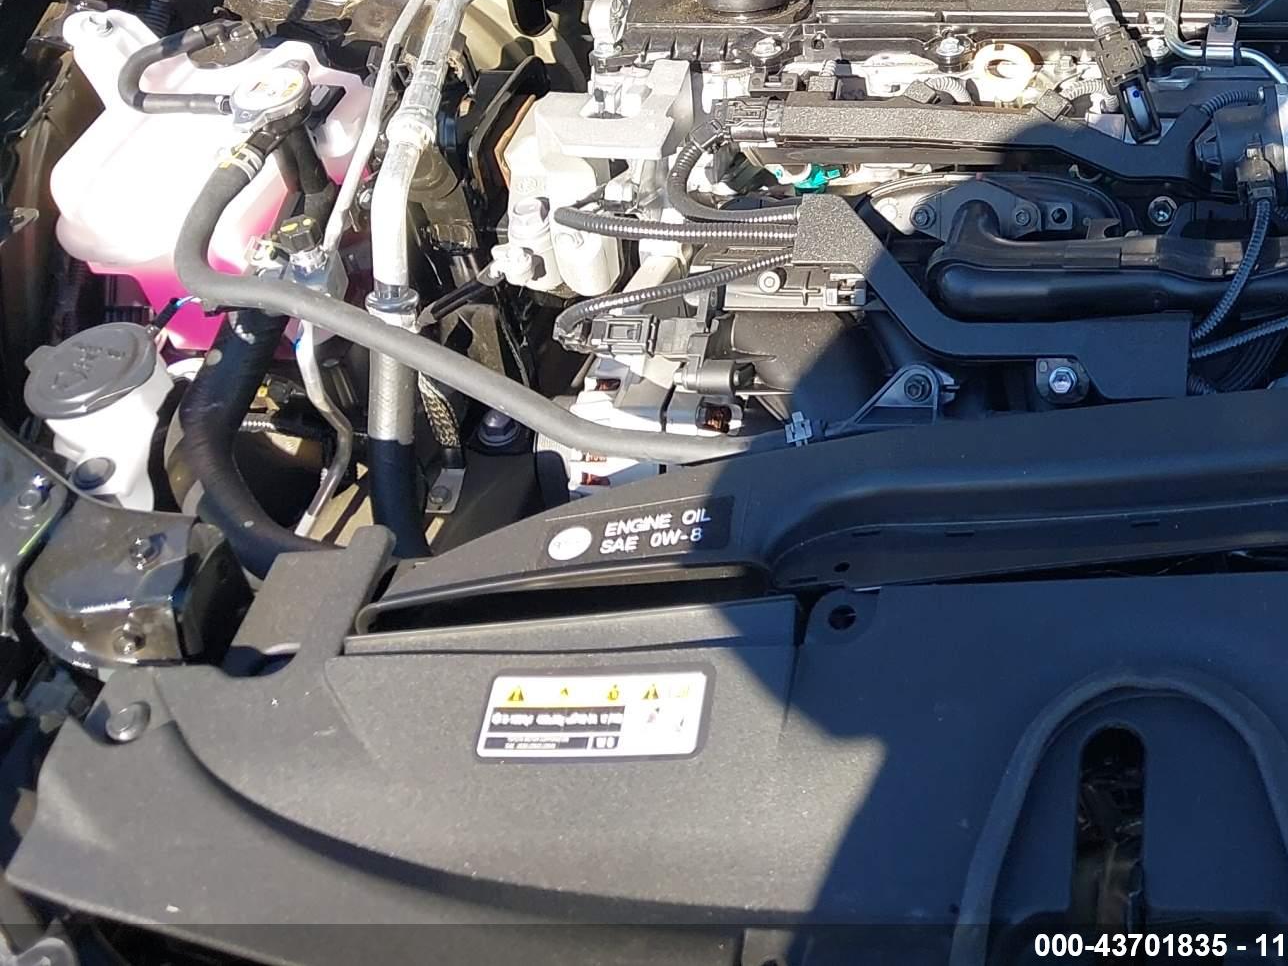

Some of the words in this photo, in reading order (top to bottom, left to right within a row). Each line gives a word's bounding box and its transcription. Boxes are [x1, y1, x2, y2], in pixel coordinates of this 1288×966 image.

[604, 513, 673, 537] ENGINE
[681, 509, 712, 525] OIL
[599, 535, 640, 554] SAE
[650, 527, 703, 547] 0W-8
